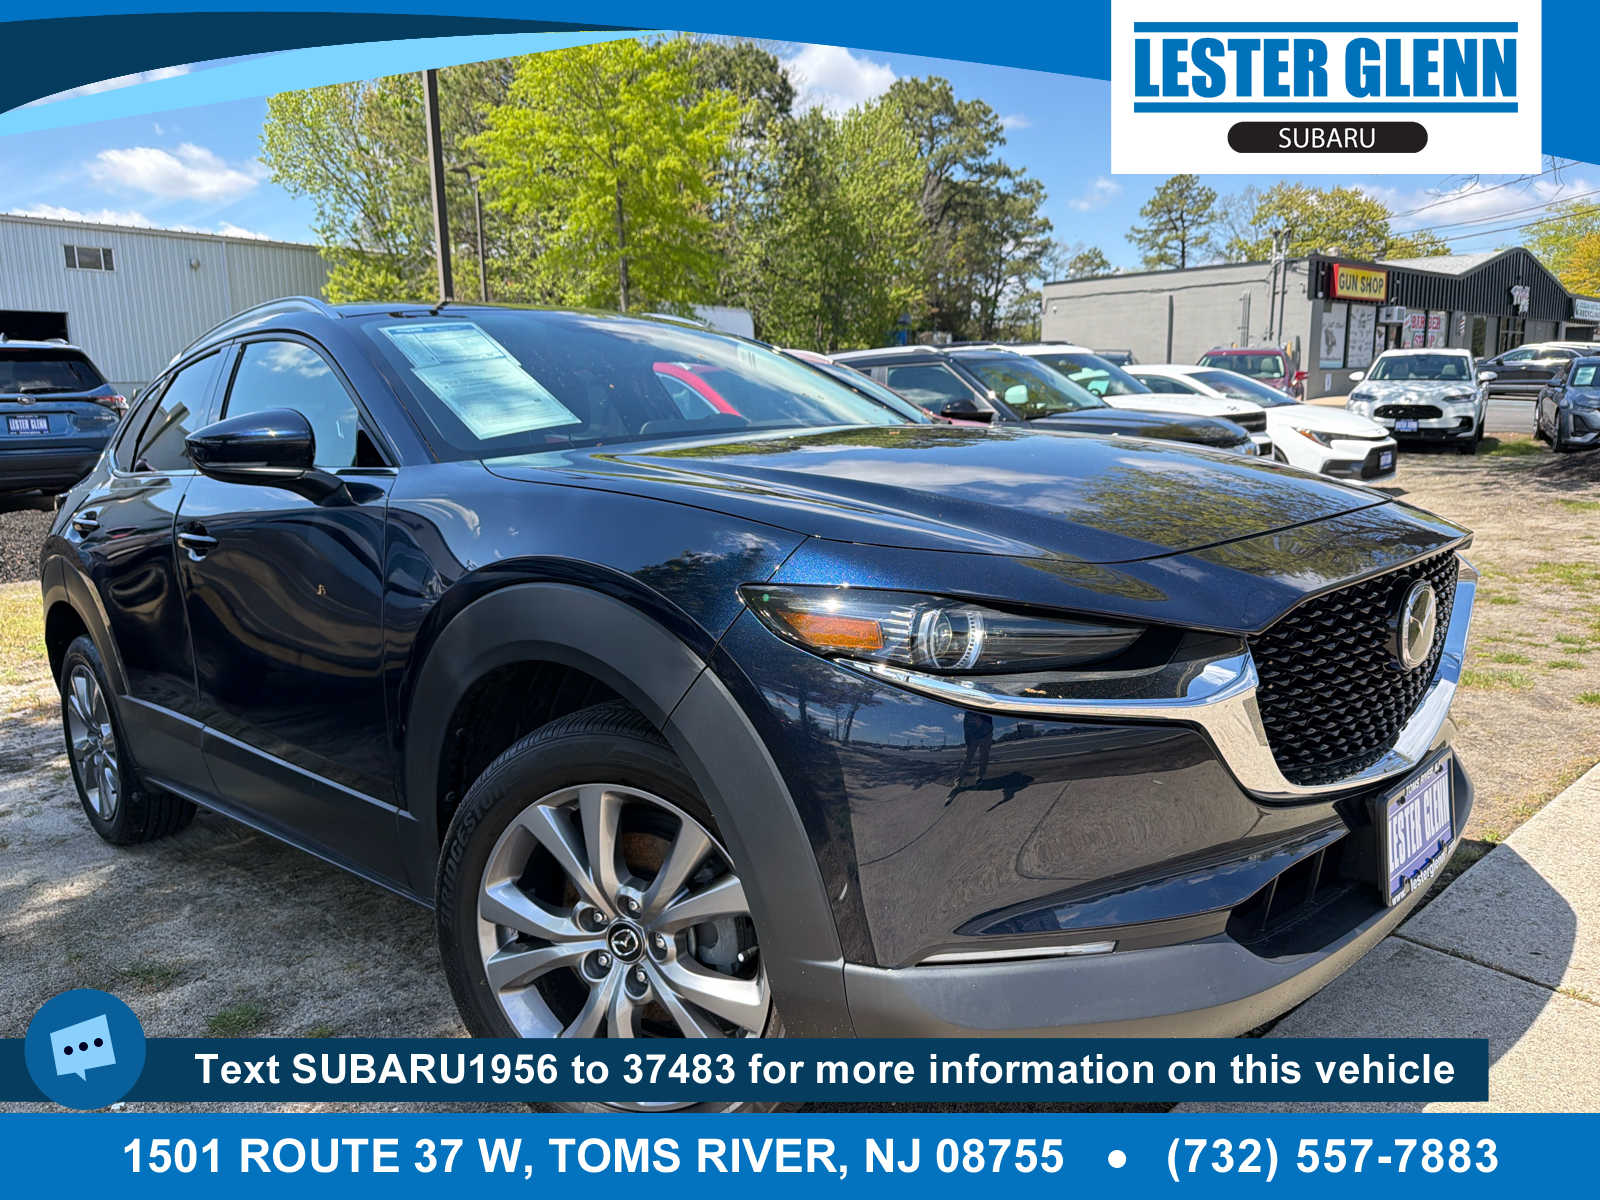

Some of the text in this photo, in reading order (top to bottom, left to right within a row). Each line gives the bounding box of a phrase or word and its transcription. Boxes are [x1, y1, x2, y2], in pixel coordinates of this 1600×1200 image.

[1339, 272, 1384, 294] GUN SHOP
[440, 778, 514, 928] BRIDGESTON
[1389, 773, 1450, 873] LESTER GLENN
